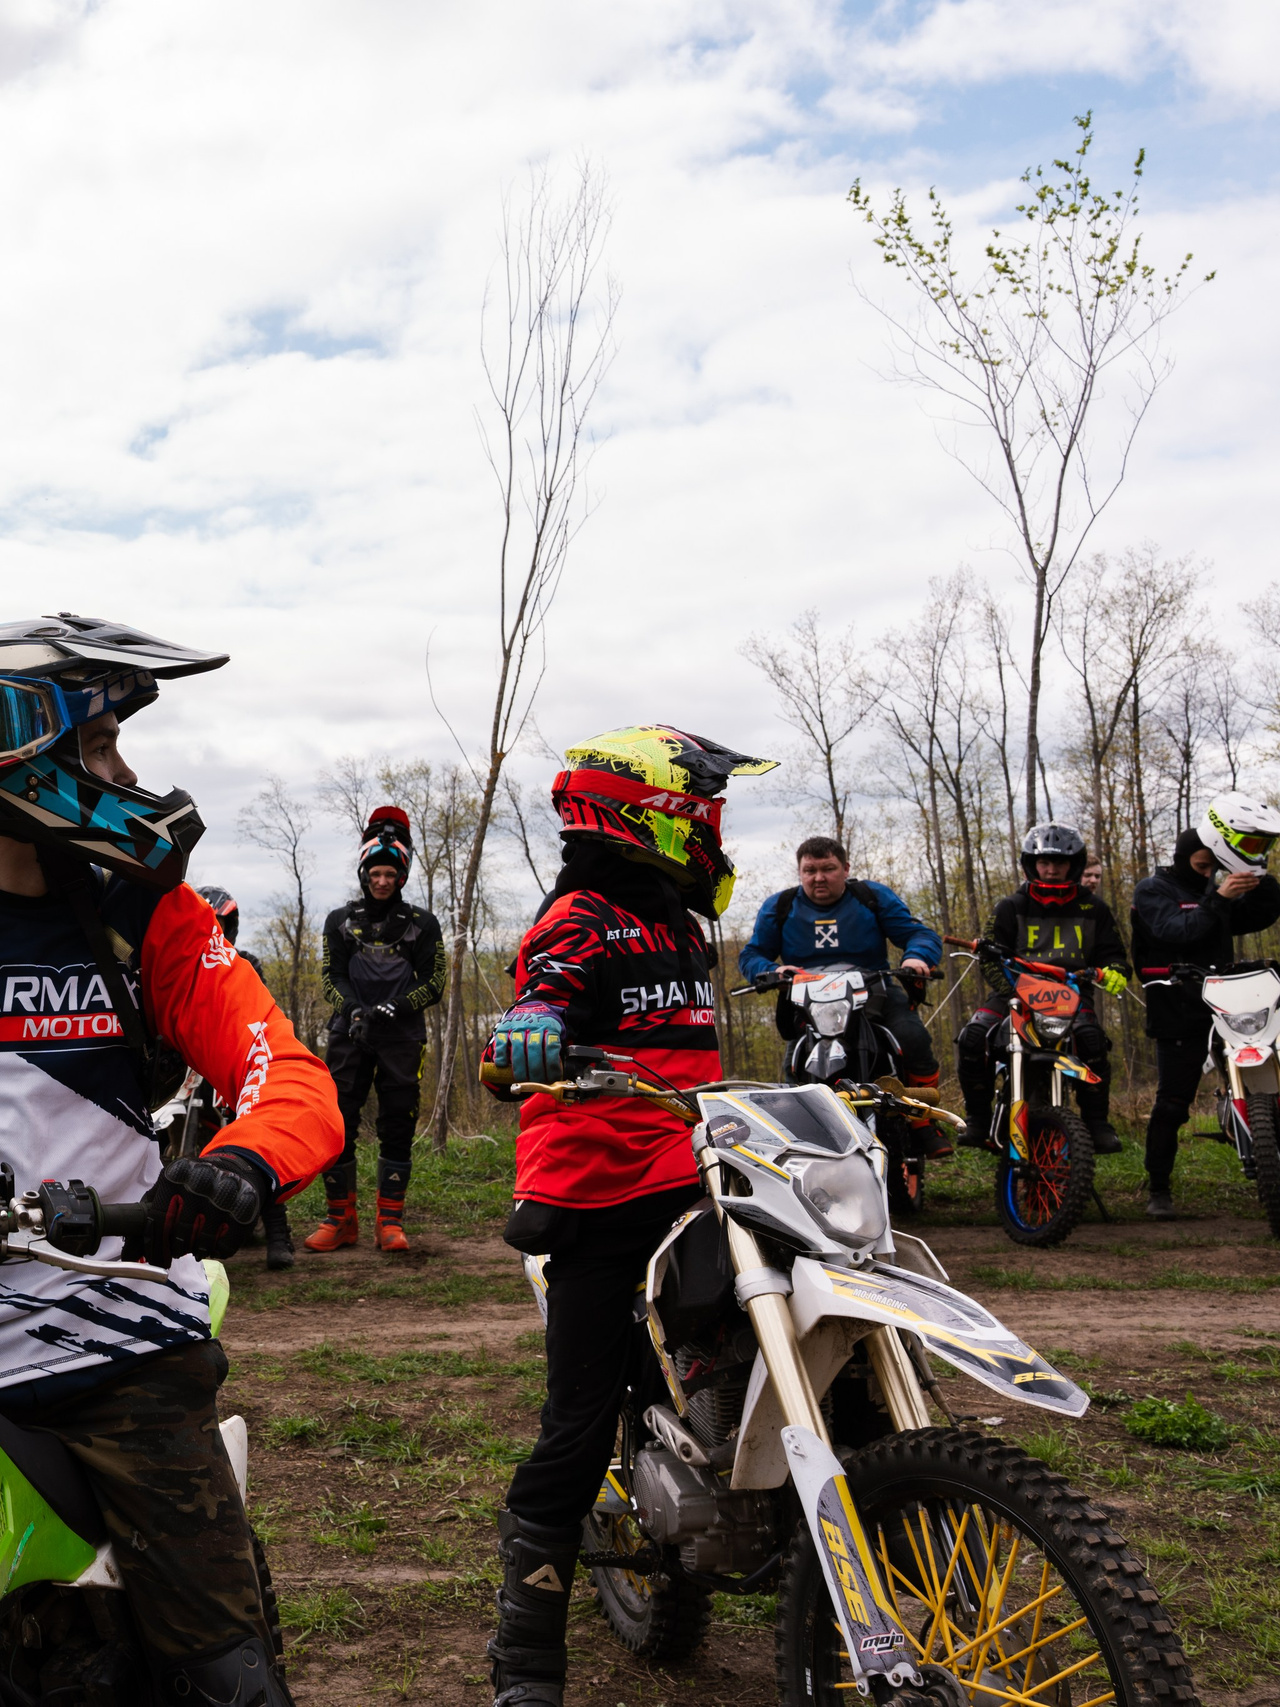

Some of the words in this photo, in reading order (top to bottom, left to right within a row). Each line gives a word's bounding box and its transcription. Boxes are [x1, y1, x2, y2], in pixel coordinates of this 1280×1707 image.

[623, 928, 641, 938] CAT
[1027, 925, 1083, 949] FLY
[1028, 987, 1071, 1005] KAYO
[852, 1288, 908, 1311] MOJORACING
[1013, 1372, 1068, 1384] BSE
[820, 1517, 871, 1627] BSE
